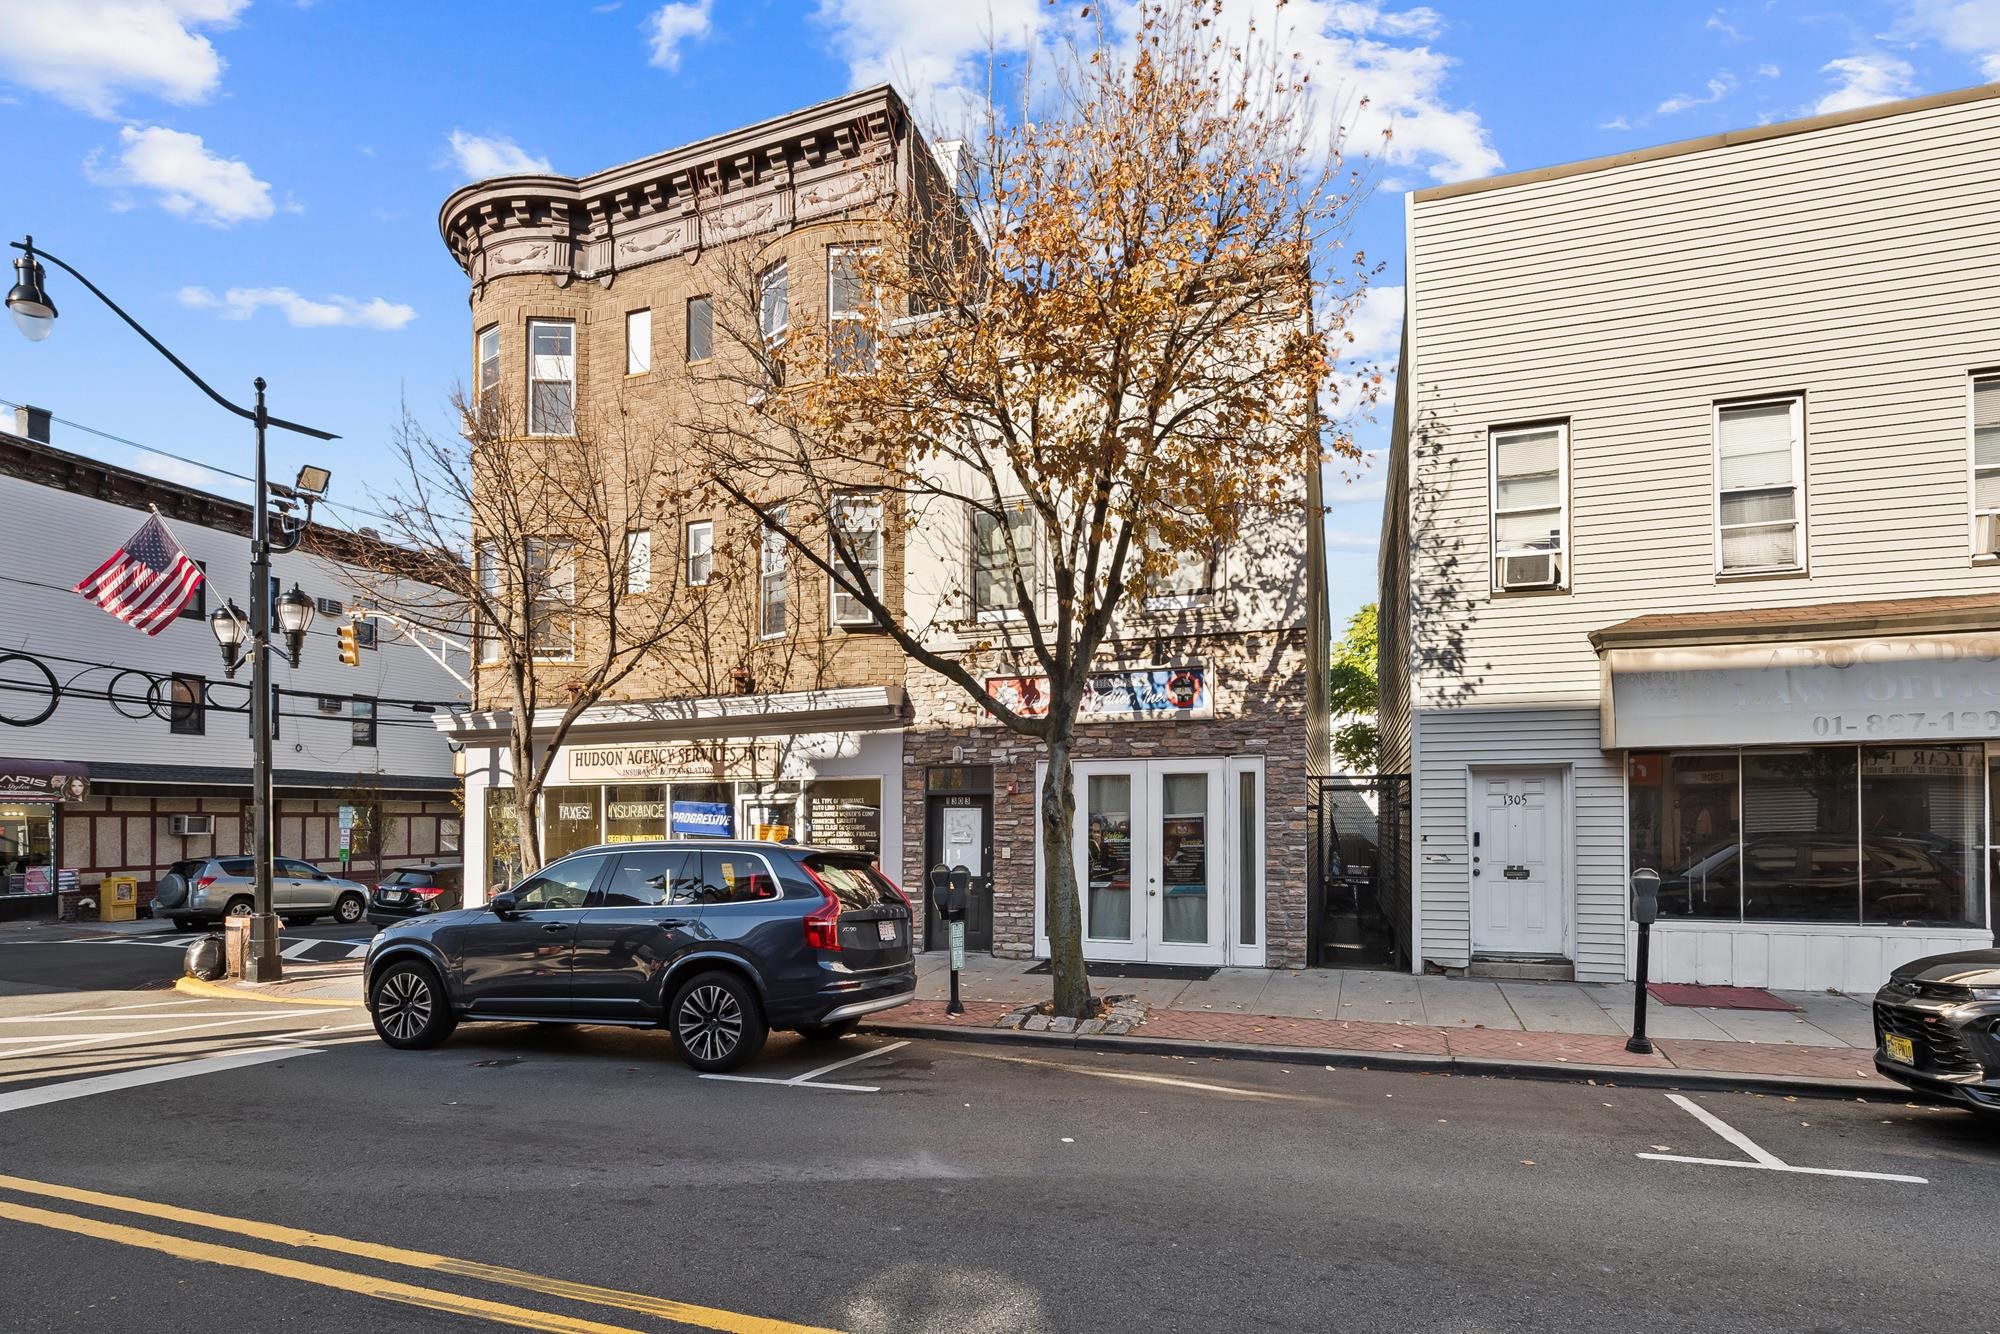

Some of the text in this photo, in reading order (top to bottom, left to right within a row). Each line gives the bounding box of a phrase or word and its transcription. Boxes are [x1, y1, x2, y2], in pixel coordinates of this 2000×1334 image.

[575, 745, 769, 767] HUDSON AGENCY SERVICES, INC.
[622, 768, 658, 777] INSURANCE
[821, 797, 833, 805] TYPE
[1503, 794, 1528, 807] 1305
[559, 805, 590, 820] TAXES
[608, 803, 665, 818] INSURANCE
[672, 812, 732, 827] PROGRESSIVE
